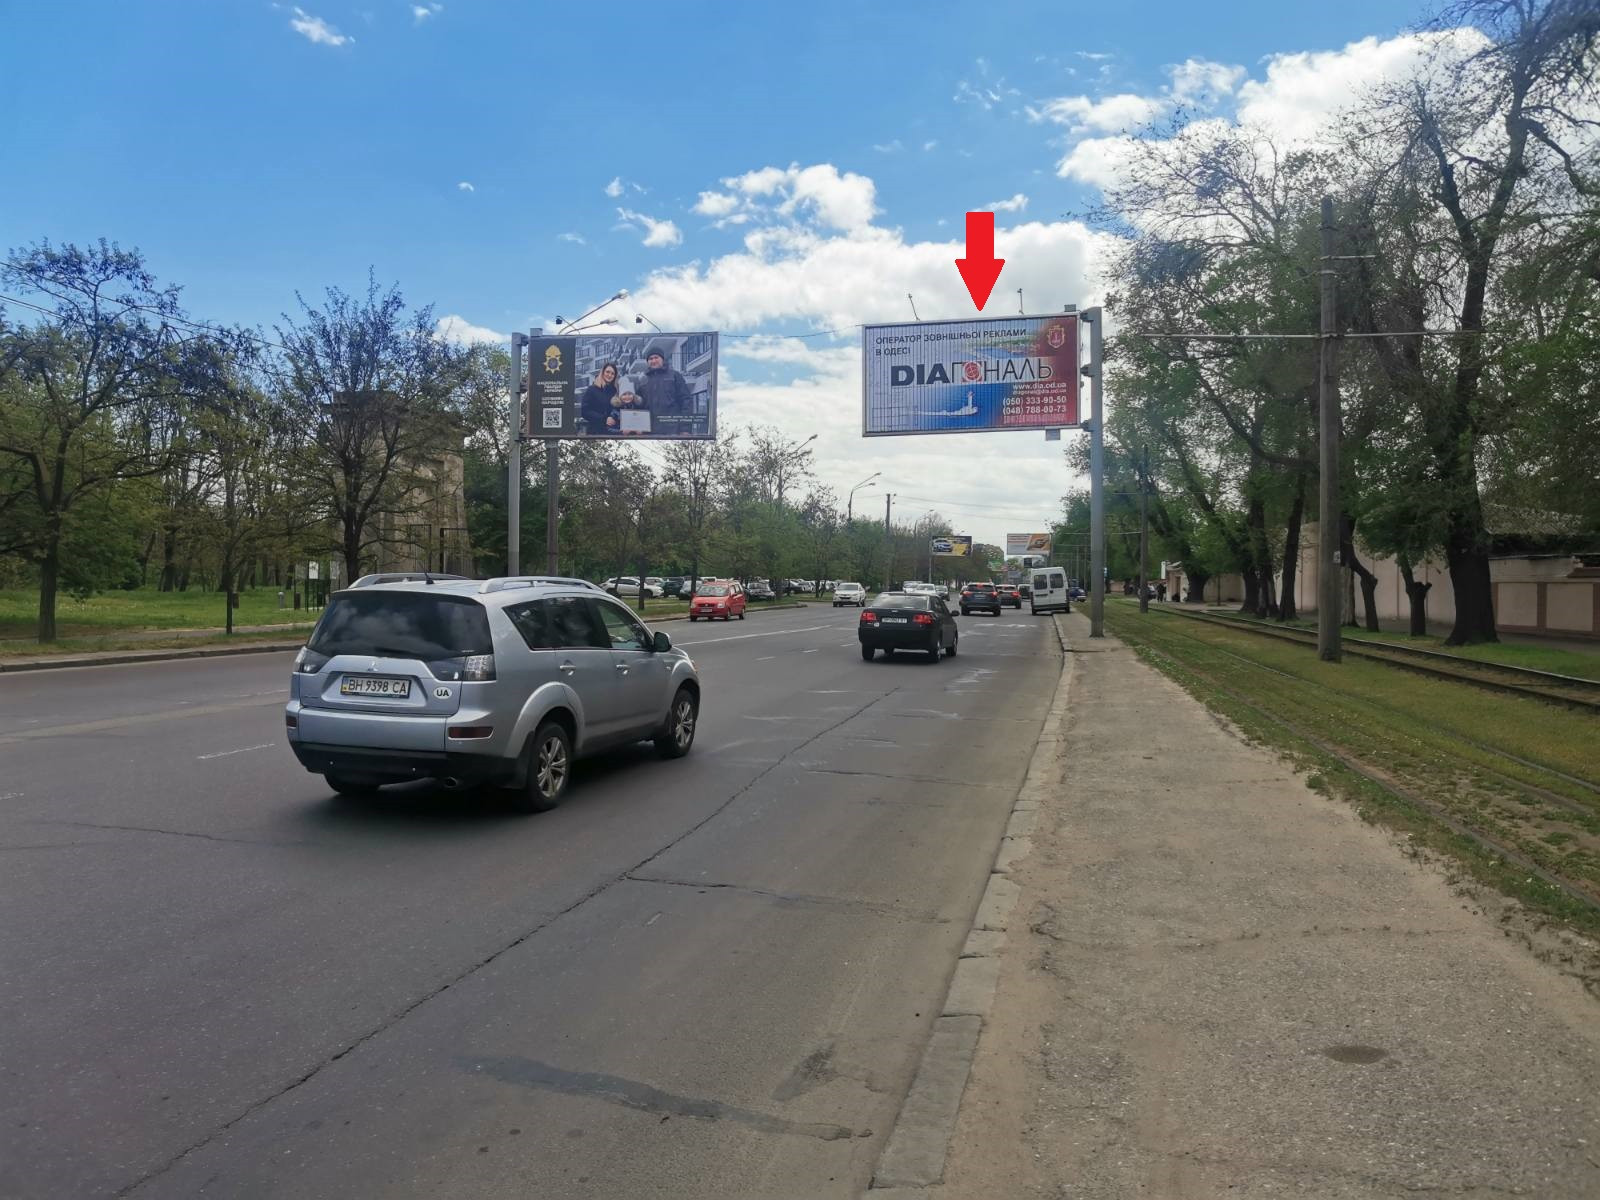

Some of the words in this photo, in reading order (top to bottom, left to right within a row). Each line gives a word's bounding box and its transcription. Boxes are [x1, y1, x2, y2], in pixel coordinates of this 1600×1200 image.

[875, 334, 922, 345] ОПЕРАТОР
[983, 328, 1027, 338] РЕКЛАМИ
[875, 348, 882, 356] В
[883, 346, 911, 357] ОДЕСІ
[1012, 382, 1067, 390] www.dia.od.ua
[1002, 397, 1024, 407] (050)
[1025, 395, 1067, 405] 333-90-50
[1002, 407, 1024, 416] (048)
[348, 680, 363, 692] BH
[365, 681, 389, 693] 9398
[392, 682, 407, 694] CA
